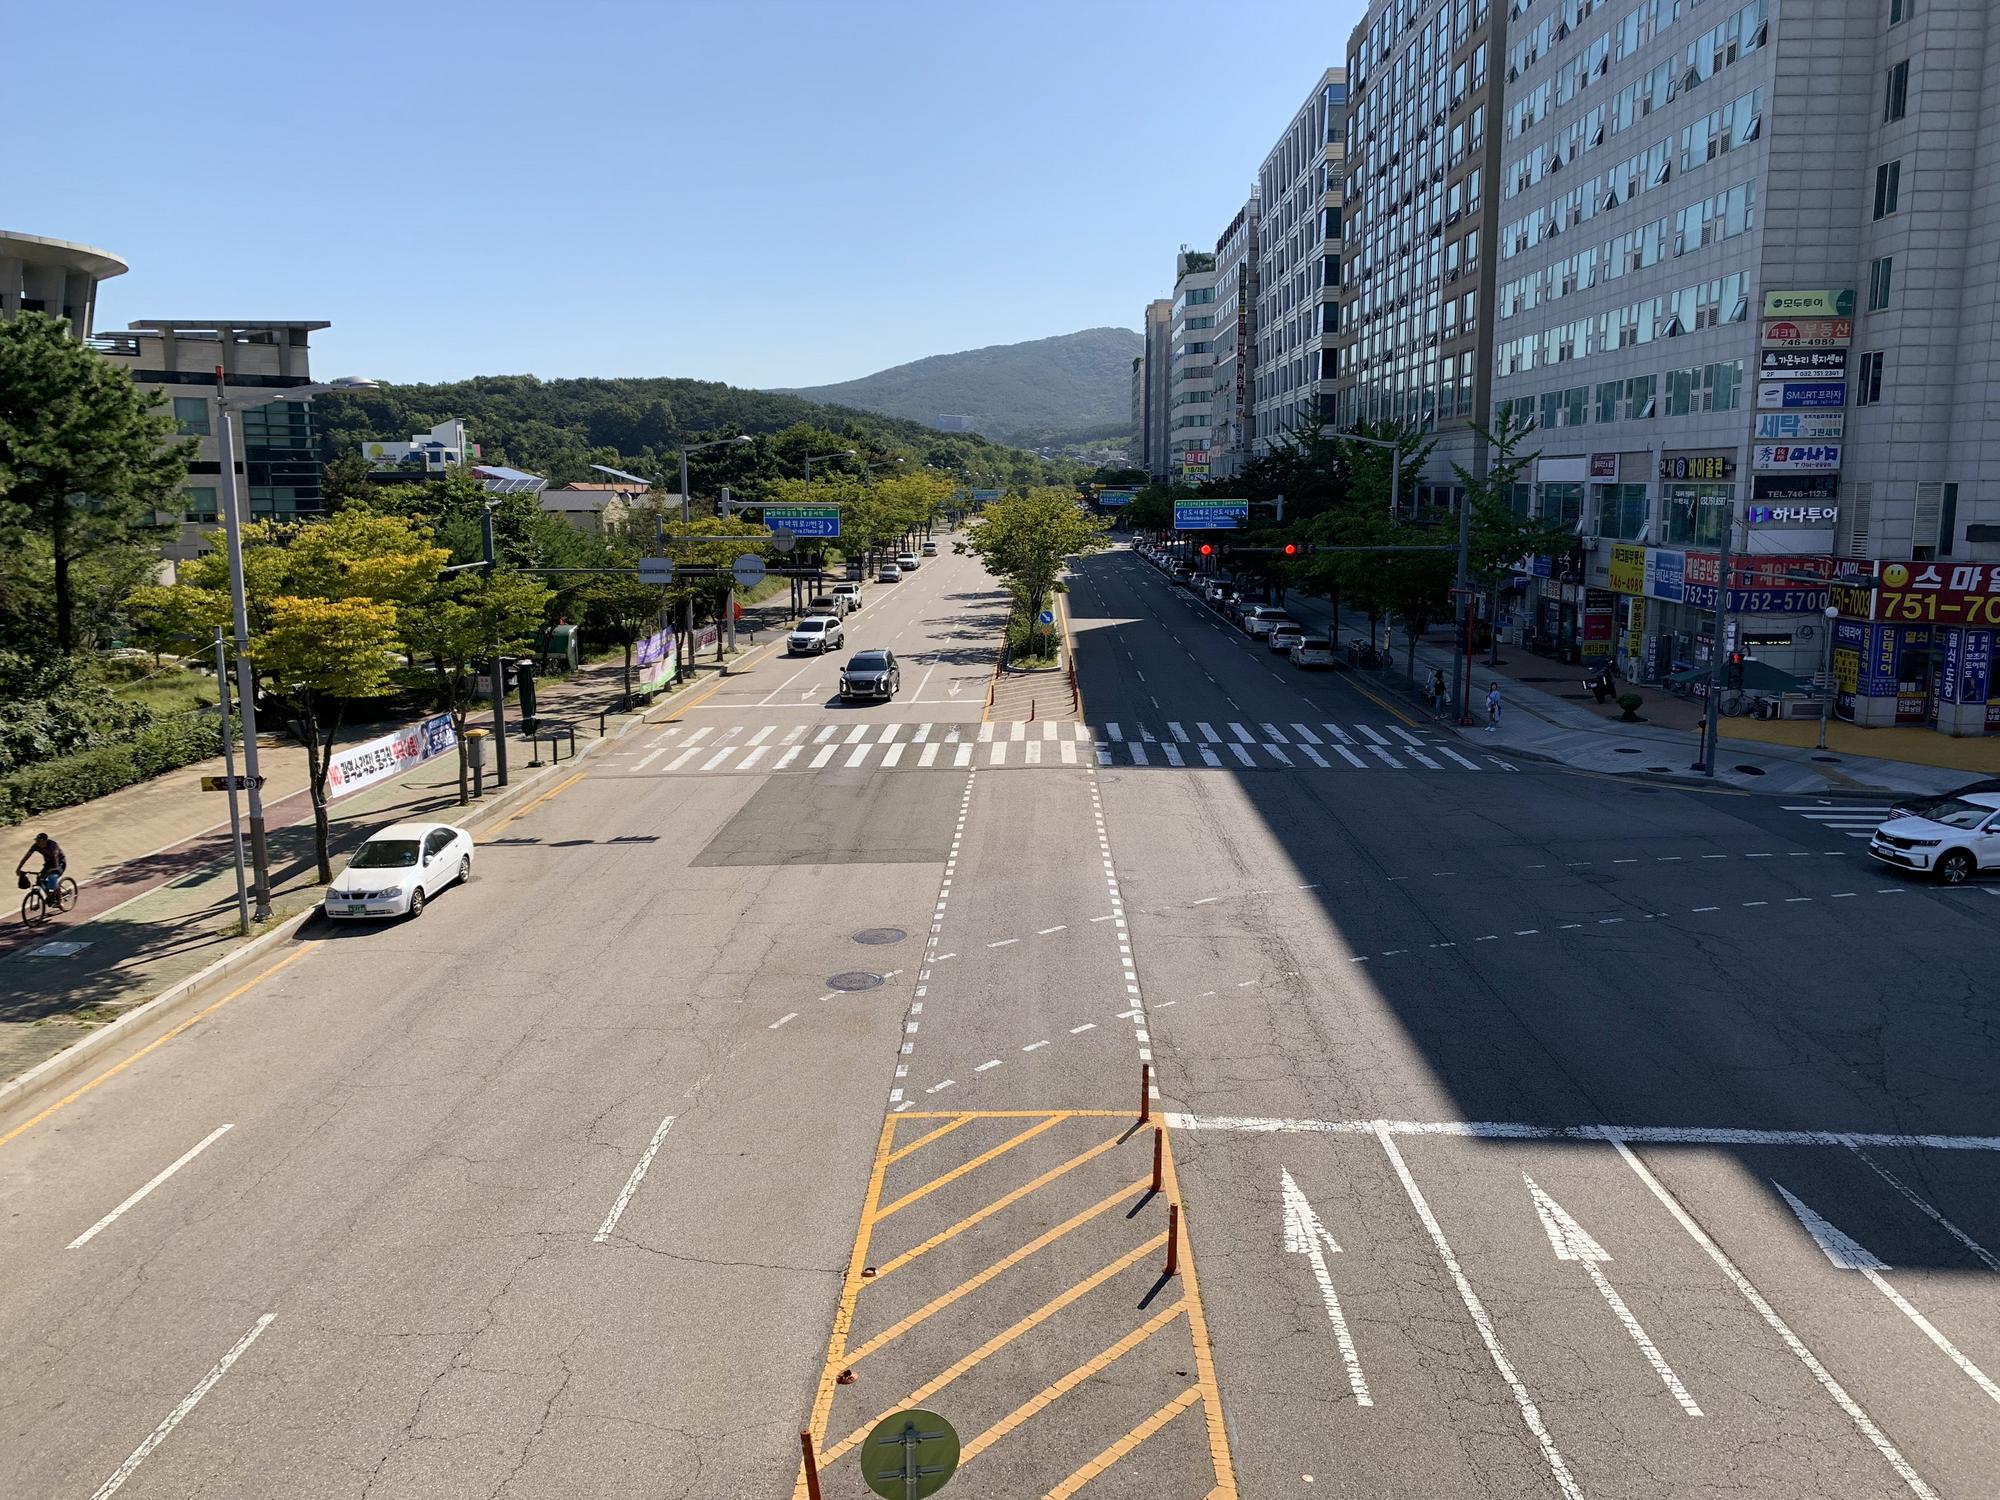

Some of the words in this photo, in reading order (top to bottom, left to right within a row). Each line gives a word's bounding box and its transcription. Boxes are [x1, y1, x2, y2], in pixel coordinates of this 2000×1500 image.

[1784, 298, 1823, 308] 모두투어
[1805, 322, 1850, 338] 부동산
[1778, 354, 1808, 366] 가온누리
[1811, 354, 1843, 366] 복지센터
[1760, 415, 1800, 438] 세탁
[1688, 457, 1723, 478] 바이올린
[1772, 506, 1838, 522] 하나투어
[1686, 558, 1735, 585] 제일공인중사
[1610, 574, 1643, 592] 746-4989
[1684, 585, 1732, 609] 752-570
[1739, 592, 1827, 610] 752-5700
[1838, 625, 1862, 640] 인테리어
[1880, 629, 1894, 675] 인테리어
